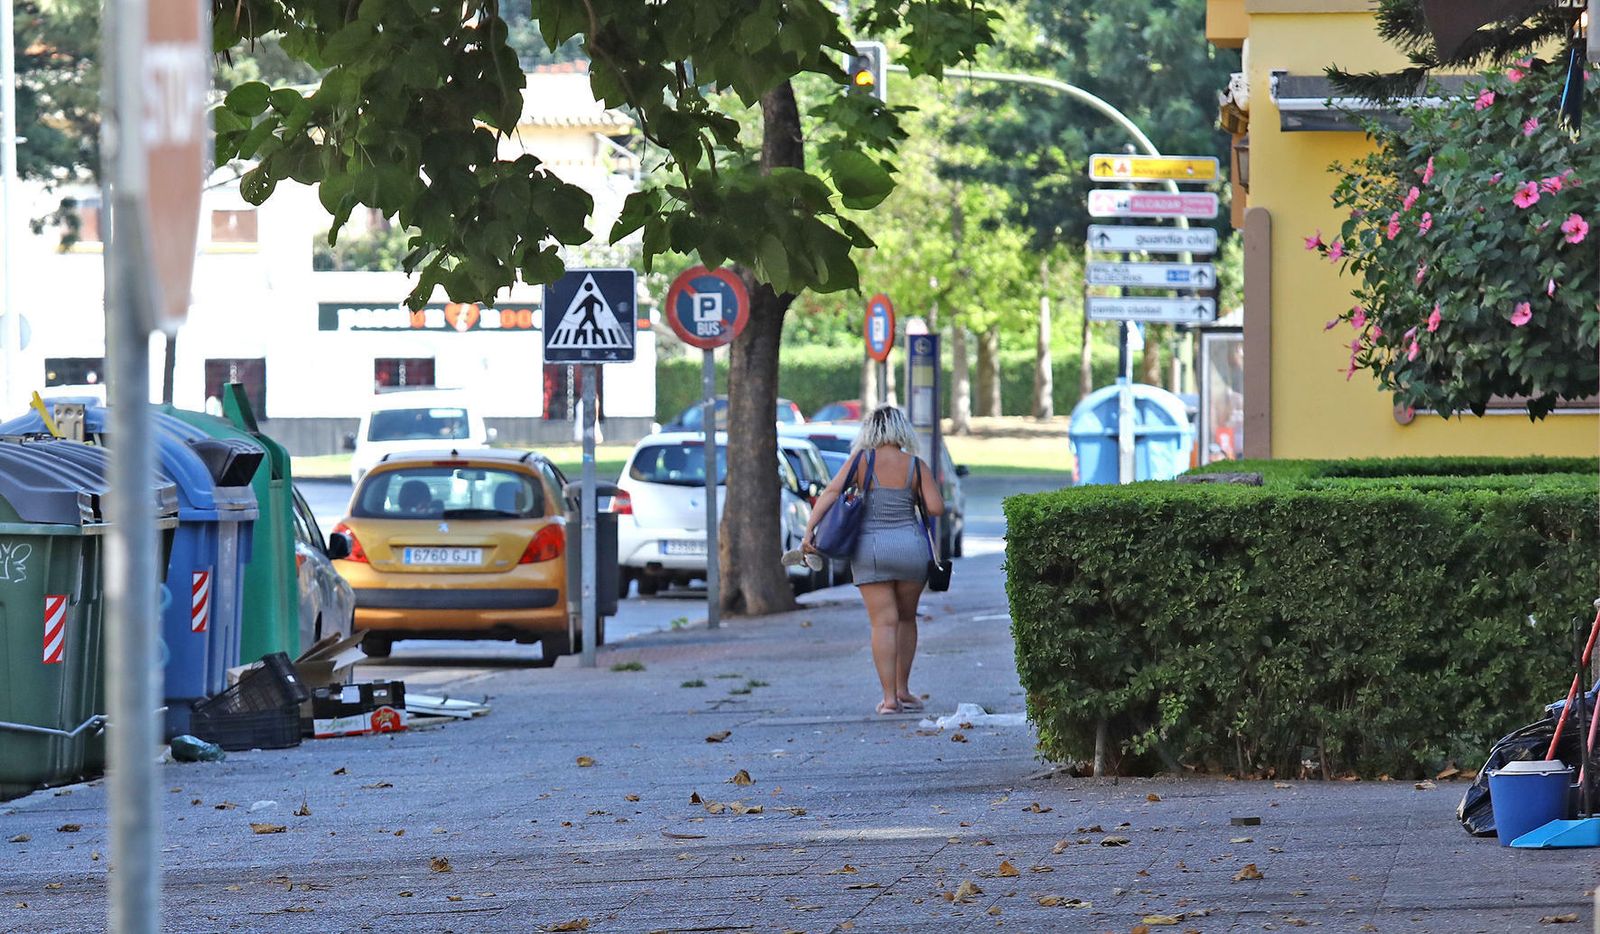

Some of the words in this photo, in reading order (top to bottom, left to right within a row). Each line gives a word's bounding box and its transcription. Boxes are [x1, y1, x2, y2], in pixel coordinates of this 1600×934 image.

[1135, 232, 1183, 245] guardia
[1187, 233, 1211, 245] civil
[700, 297, 716, 319] P
[1092, 304, 1125, 314] centro
[1127, 304, 1162, 314] ciudad
[697, 322, 720, 336] BUS
[414, 548, 449, 562] 6760
[452, 549, 478, 562] GJT
